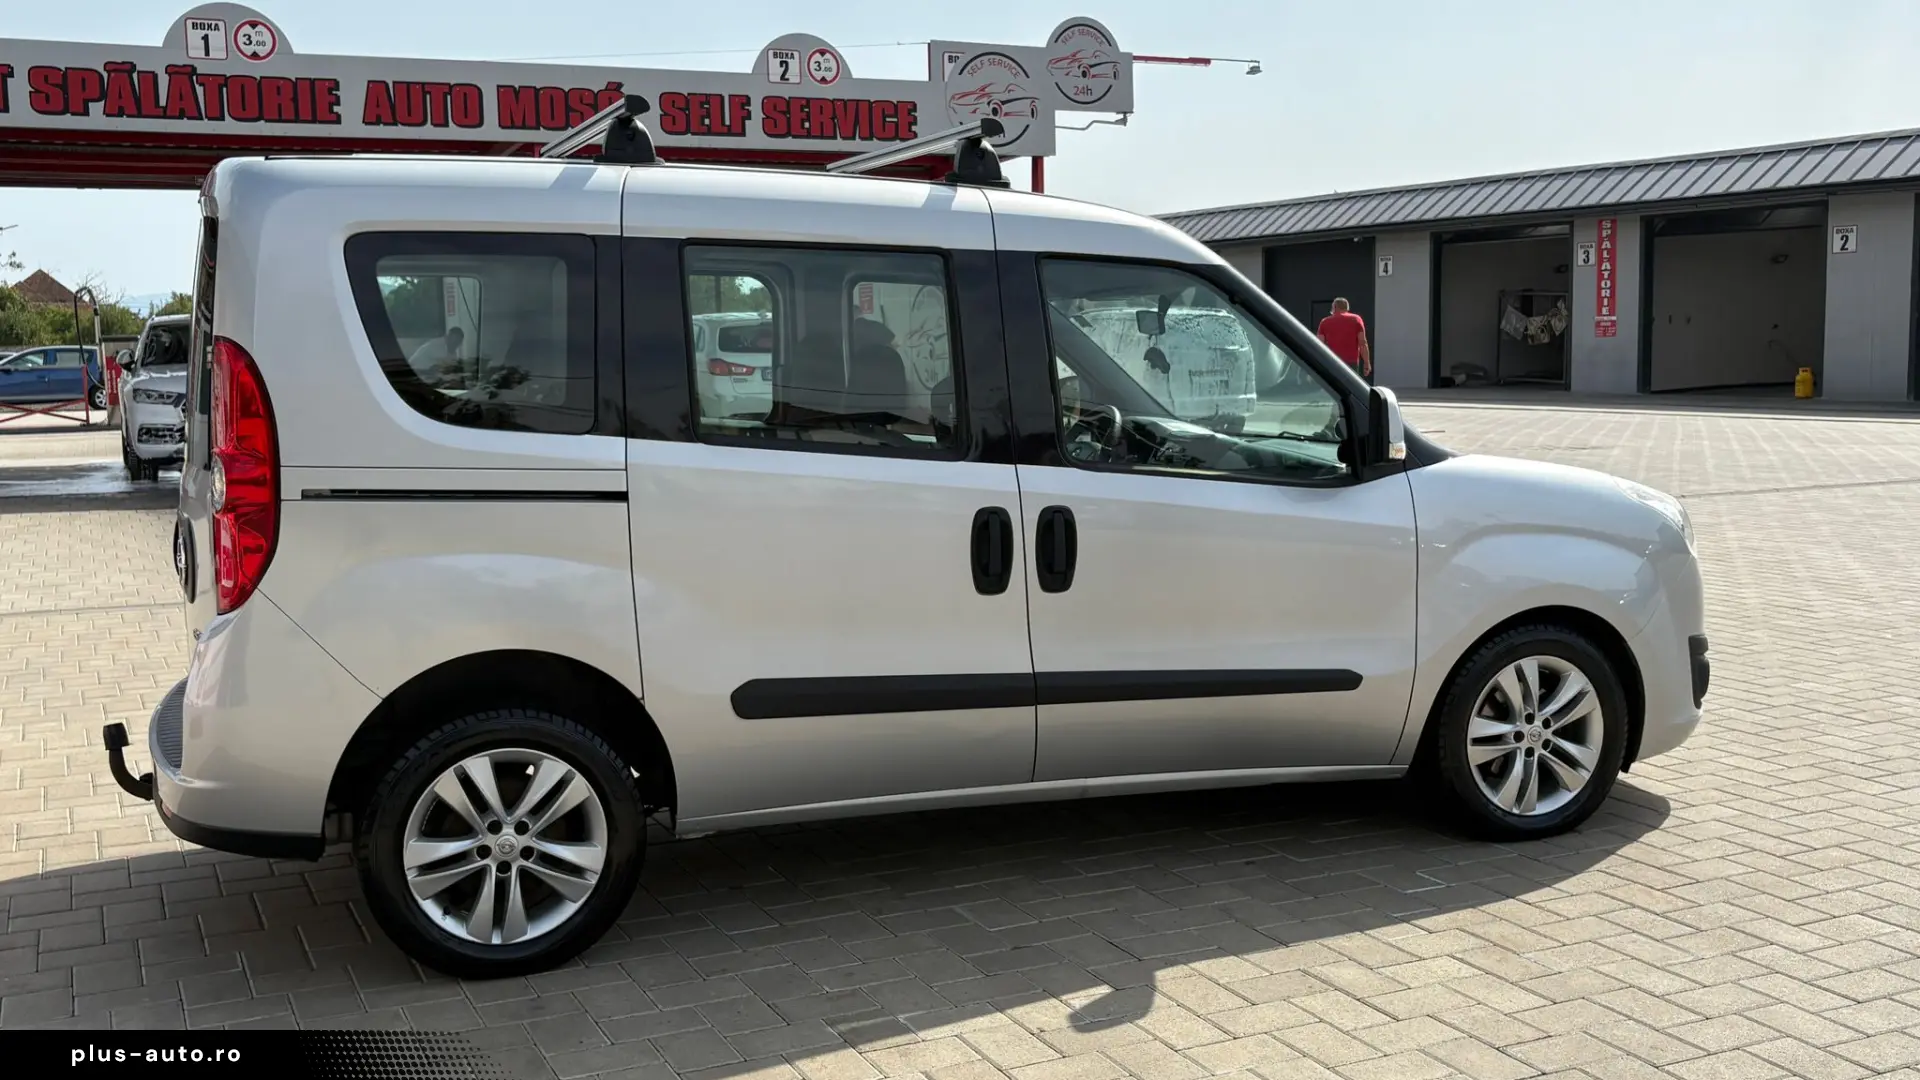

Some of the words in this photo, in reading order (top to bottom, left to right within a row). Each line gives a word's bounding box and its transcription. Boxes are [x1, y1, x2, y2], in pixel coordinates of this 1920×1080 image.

[191, 21, 220, 31] BOXA
[201, 33, 210, 57] 1
[773, 51, 795, 60] BOXA
[779, 60, 790, 81] 2
[967, 60, 985, 77] SELF
[987, 57, 1021, 79] SERVICE
[1073, 85, 1093, 96] 24h
[362, 79, 484, 129] AUTO
[659, 91, 752, 137] SELF
[762, 95, 918, 141] SERVICE
[1840, 234, 1849, 251] 2
[1583, 249, 1590, 264] 3
[1383, 262, 1389, 275] 4
